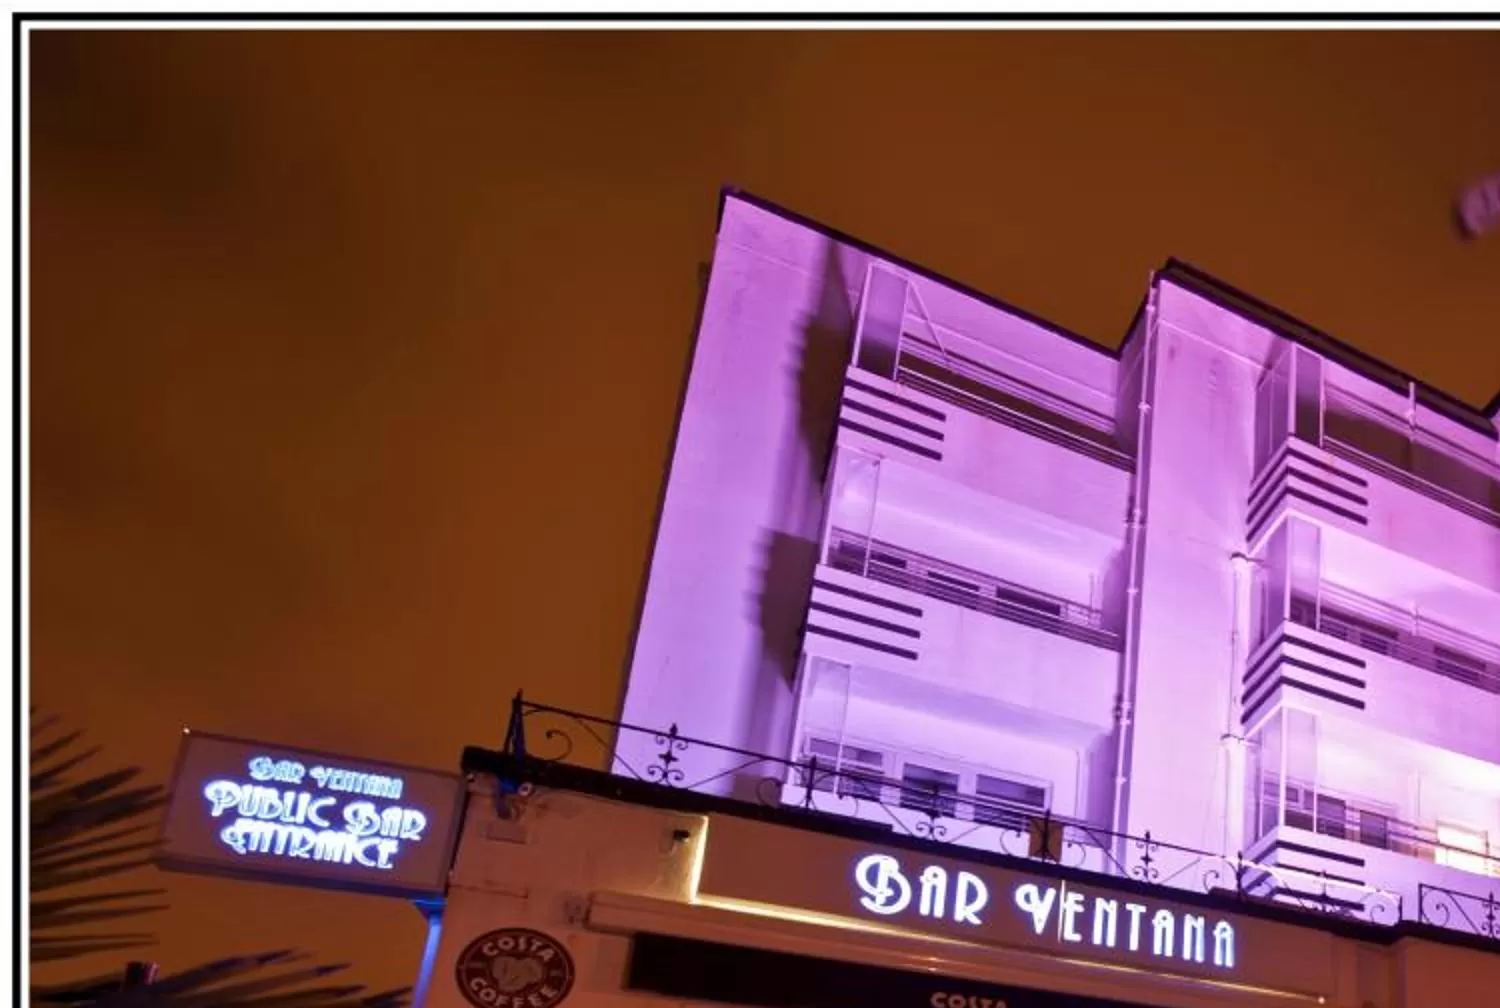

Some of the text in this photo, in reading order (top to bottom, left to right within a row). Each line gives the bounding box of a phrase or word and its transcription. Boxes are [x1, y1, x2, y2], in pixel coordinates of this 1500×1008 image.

[249, 756, 305, 784] BAR
[204, 779, 427, 841] PUBLIC BAR
[220, 818, 399, 869] ENTRANCE
[855, 853, 1236, 968] BAR VENTANA
[482, 936, 554, 961] COSTA
